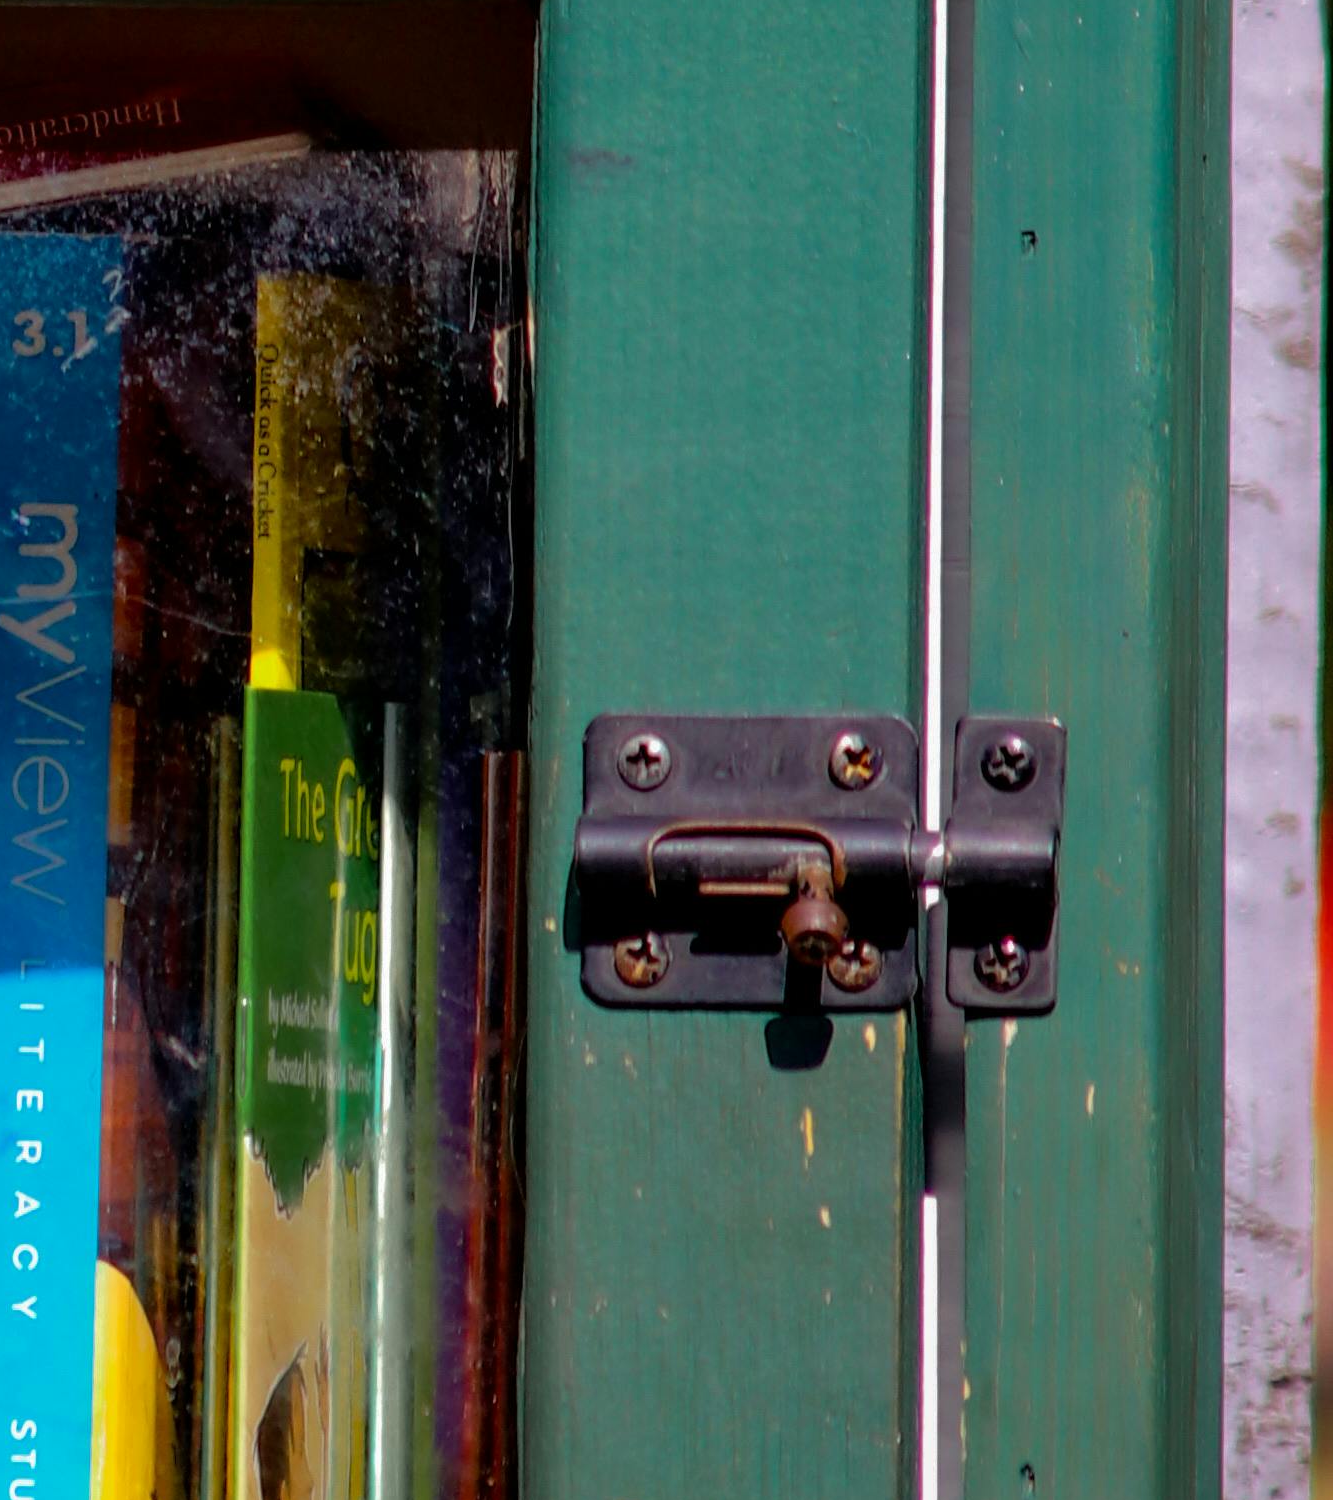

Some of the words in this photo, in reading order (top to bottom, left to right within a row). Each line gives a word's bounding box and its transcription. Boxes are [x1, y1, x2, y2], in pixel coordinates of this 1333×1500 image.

[11, 309, 91, 358] 3.1
[257, 343, 281, 411] Quick
[258, 414, 273, 444] as
[259, 445, 272, 458] a
[256, 459, 279, 542] Cricket
[279, 757, 326, 844] The
[11, 959, 46, 1320] LITERACY
